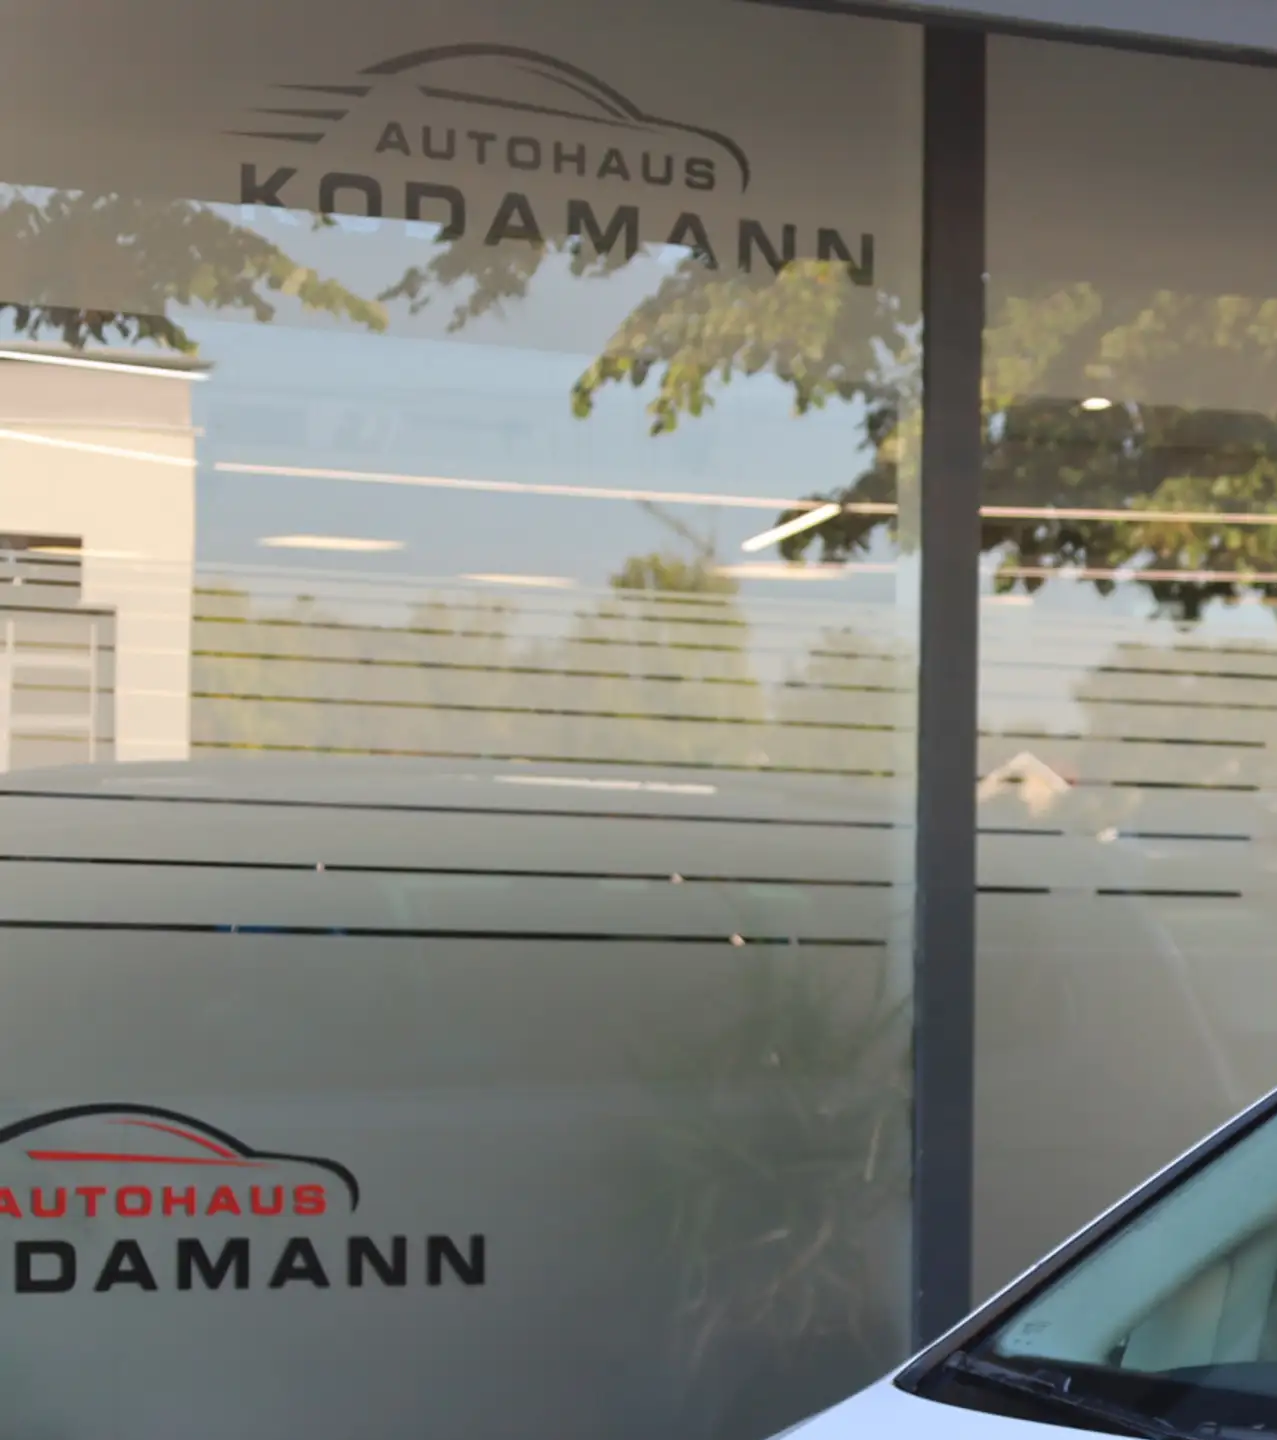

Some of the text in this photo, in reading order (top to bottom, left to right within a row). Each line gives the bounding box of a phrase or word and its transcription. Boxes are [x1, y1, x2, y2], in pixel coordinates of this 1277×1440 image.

[375, 121, 717, 191] AUTOHAUS
[240, 162, 875, 288] KODAMANN
[0, 1184, 327, 1218] AUTOHAUS
[15, 1234, 486, 1293] DAMANN
